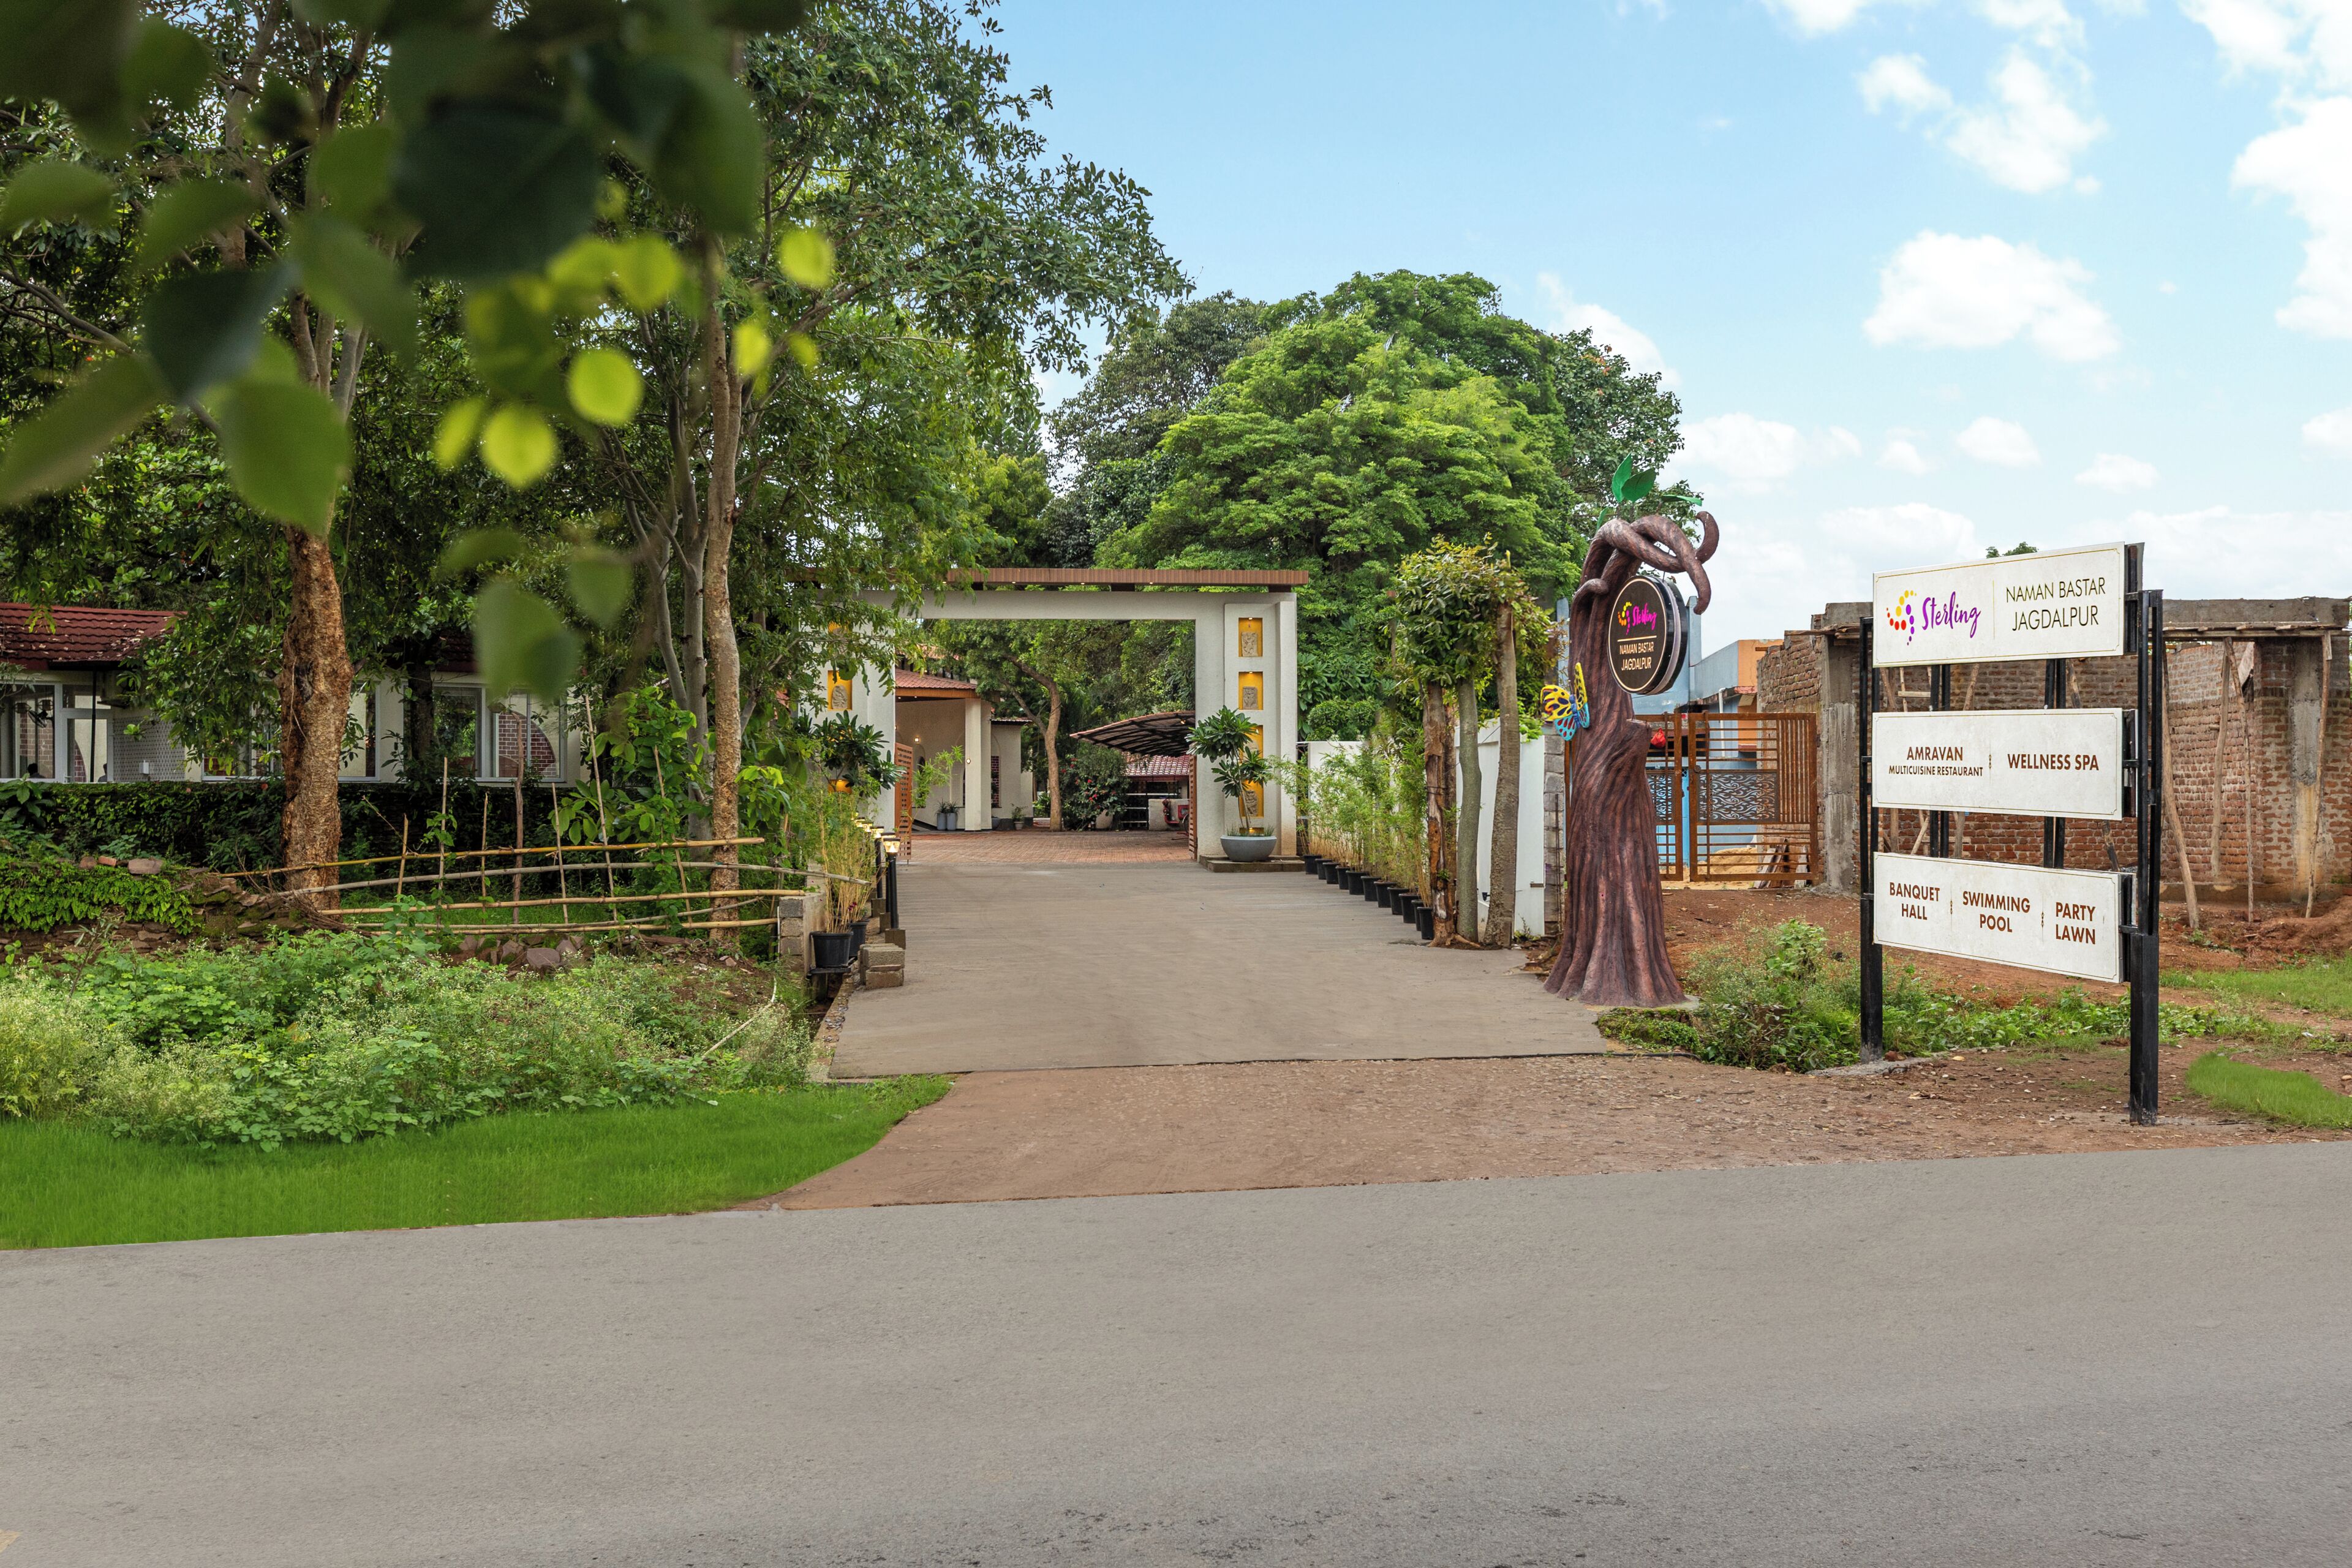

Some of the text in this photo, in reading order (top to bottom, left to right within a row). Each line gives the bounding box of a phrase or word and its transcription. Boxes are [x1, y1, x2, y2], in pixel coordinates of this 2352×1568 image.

[2006, 577, 2106, 603] NAMAN BASTAR
[1632, 603, 1657, 630] Sterling
[1921, 591, 1981, 638] Sterling
[2012, 605, 2099, 631] JAGDALPUR
[1619, 641, 1654, 655] NAMAN BASTAR
[1621, 656, 1652, 671] JAGDALPUR
[1906, 746, 1964, 761] AMRAVAN
[2007, 753, 2100, 771] WELLNESS SPA
[1888, 765, 1983, 777] MULTICUISINE RESTAURANT
[1890, 882, 1940, 902] BANQUET
[1962, 891, 2030, 913] SWIMMING
[1901, 903, 1928, 921] HALL
[2056, 902, 2096, 922] PARTY
[1980, 914, 2013, 933] POOL
[2056, 925, 2096, 945] LAWN
